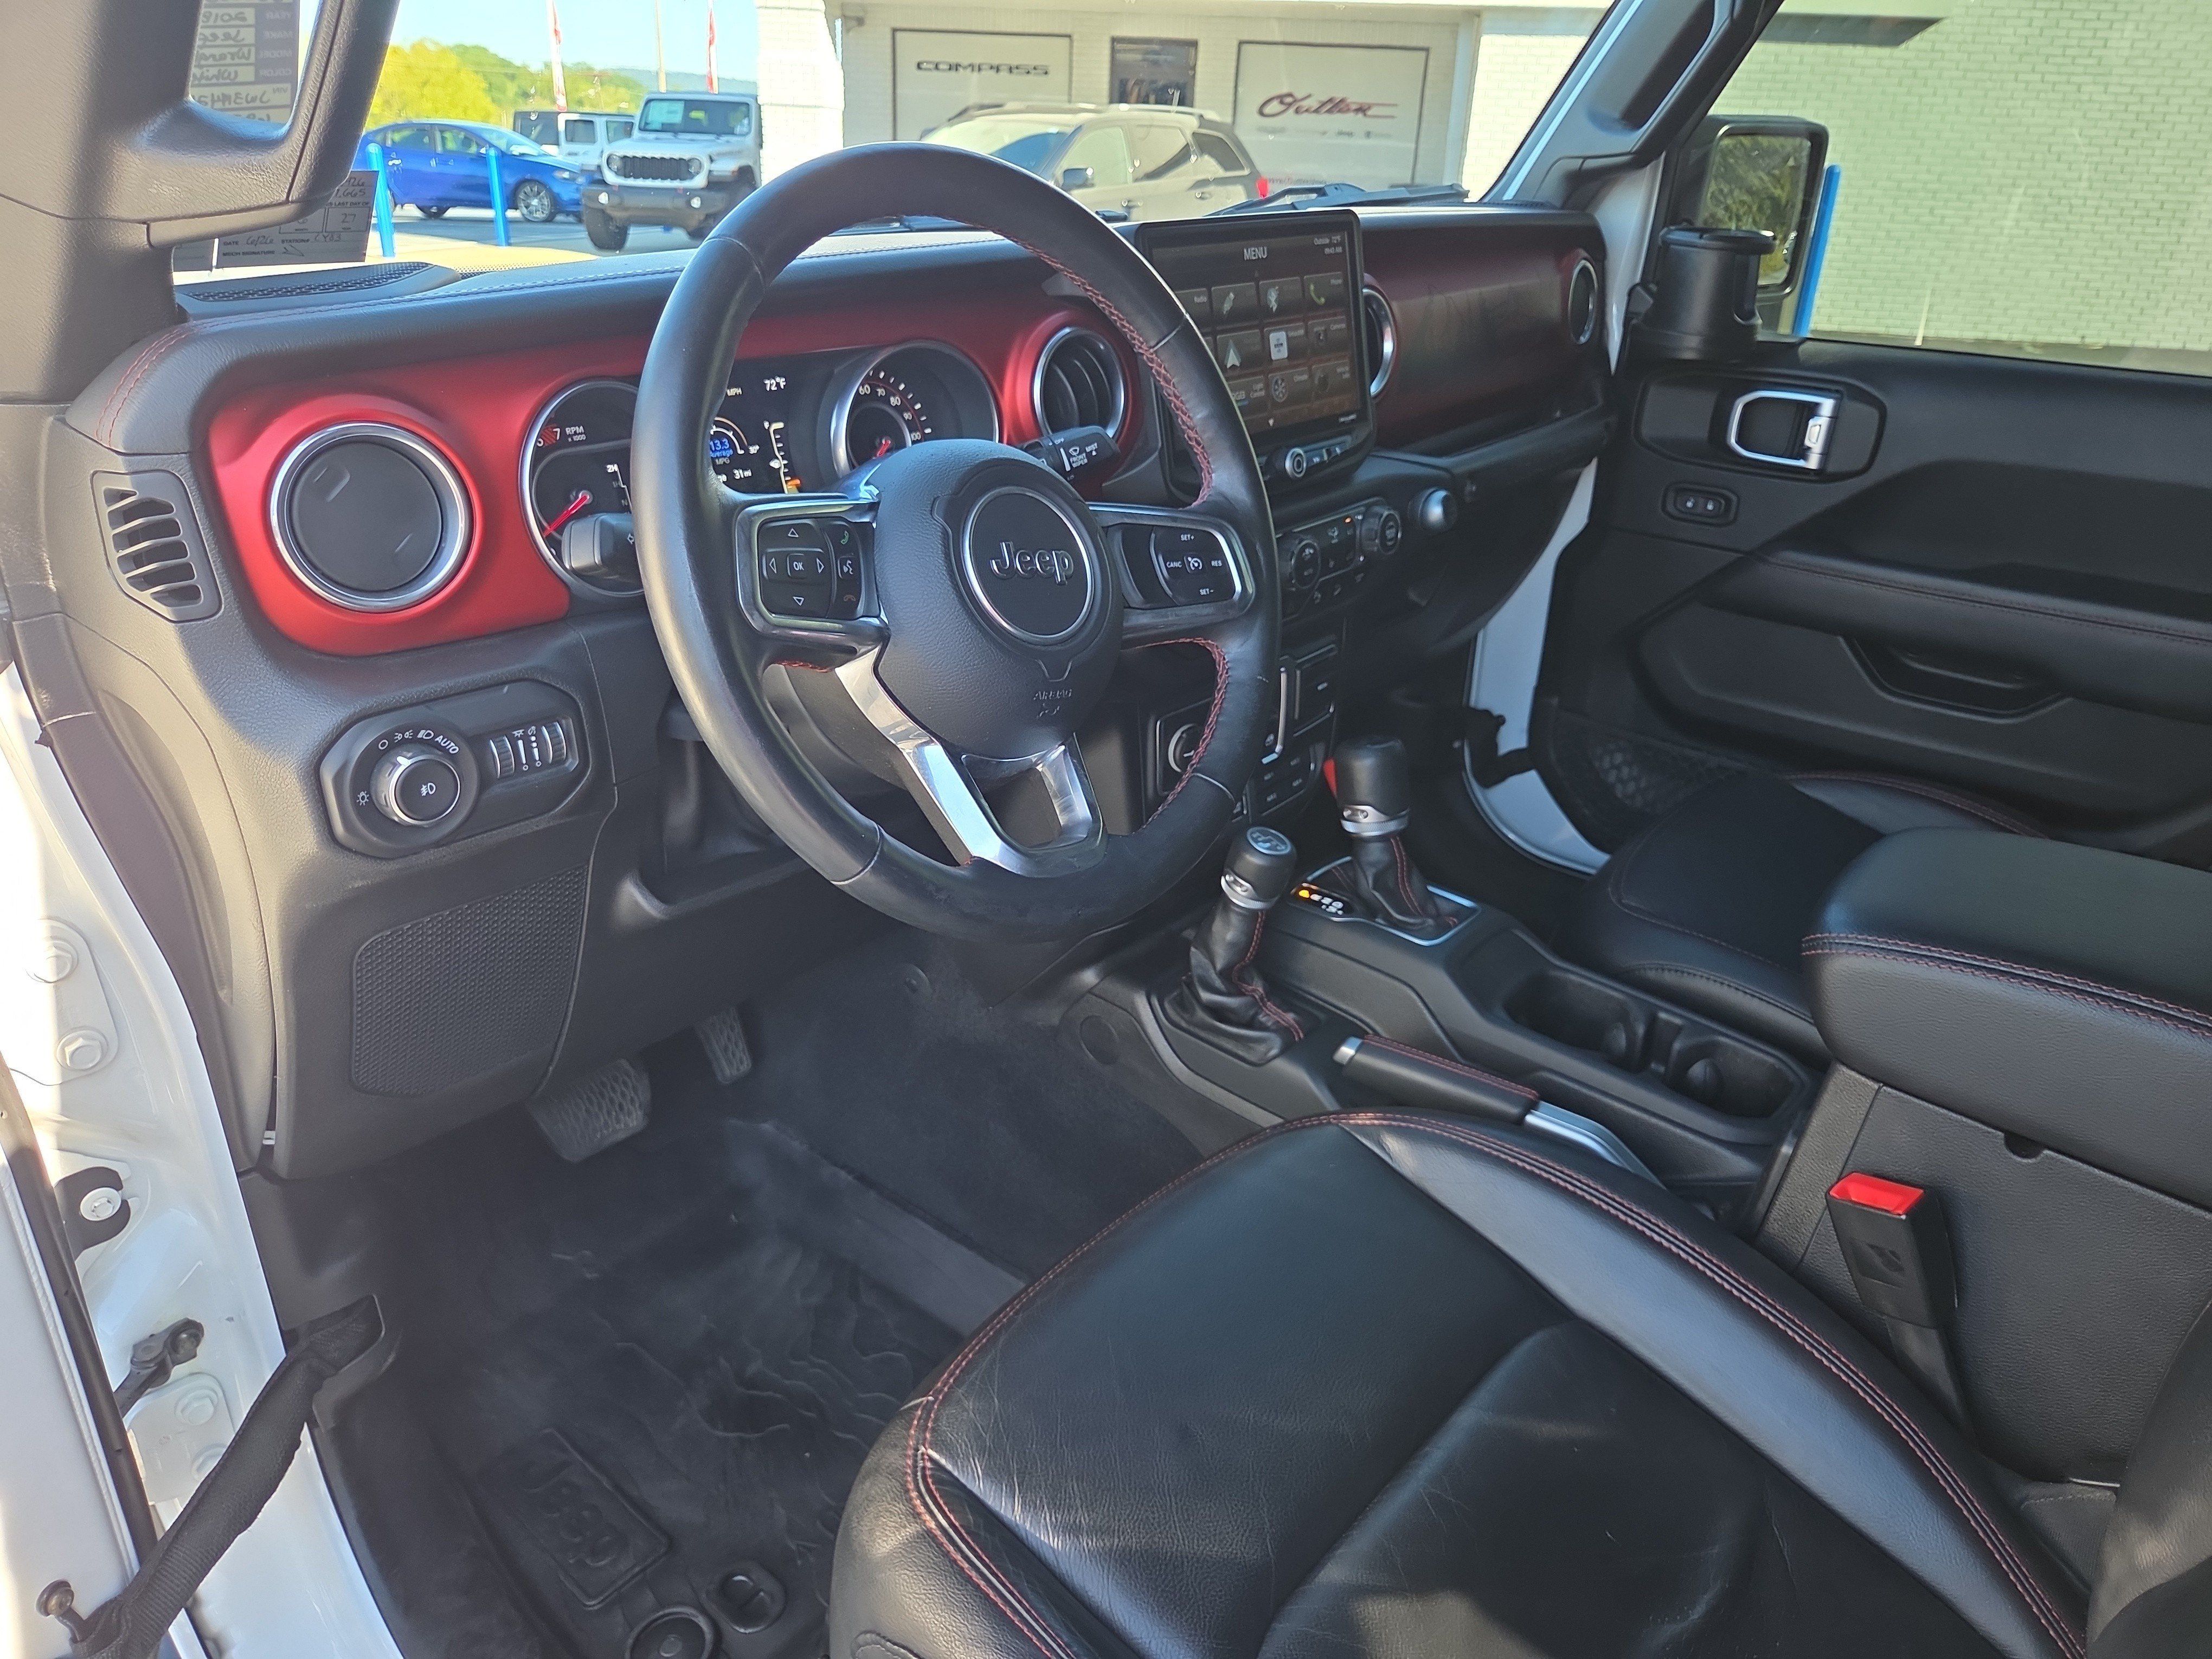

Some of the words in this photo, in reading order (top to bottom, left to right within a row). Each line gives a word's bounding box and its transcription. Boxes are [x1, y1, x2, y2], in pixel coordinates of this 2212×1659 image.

[916, 60, 1049, 76] COMPASS
[1243, 247, 1268, 261] MENU
[763, 376, 786, 391] 72°F
[859, 384, 871, 395] 60
[877, 388, 885, 396] 70
[890, 396, 901, 407] 80
[903, 411, 912, 420] 90
[552, 428, 561, 440] 7
[565, 426, 585, 435] RPM
[606, 464, 618, 473] 2H
[793, 561, 805, 571] OK
[990, 541, 1074, 586] Jeep
[434, 735, 460, 755] AUTO
